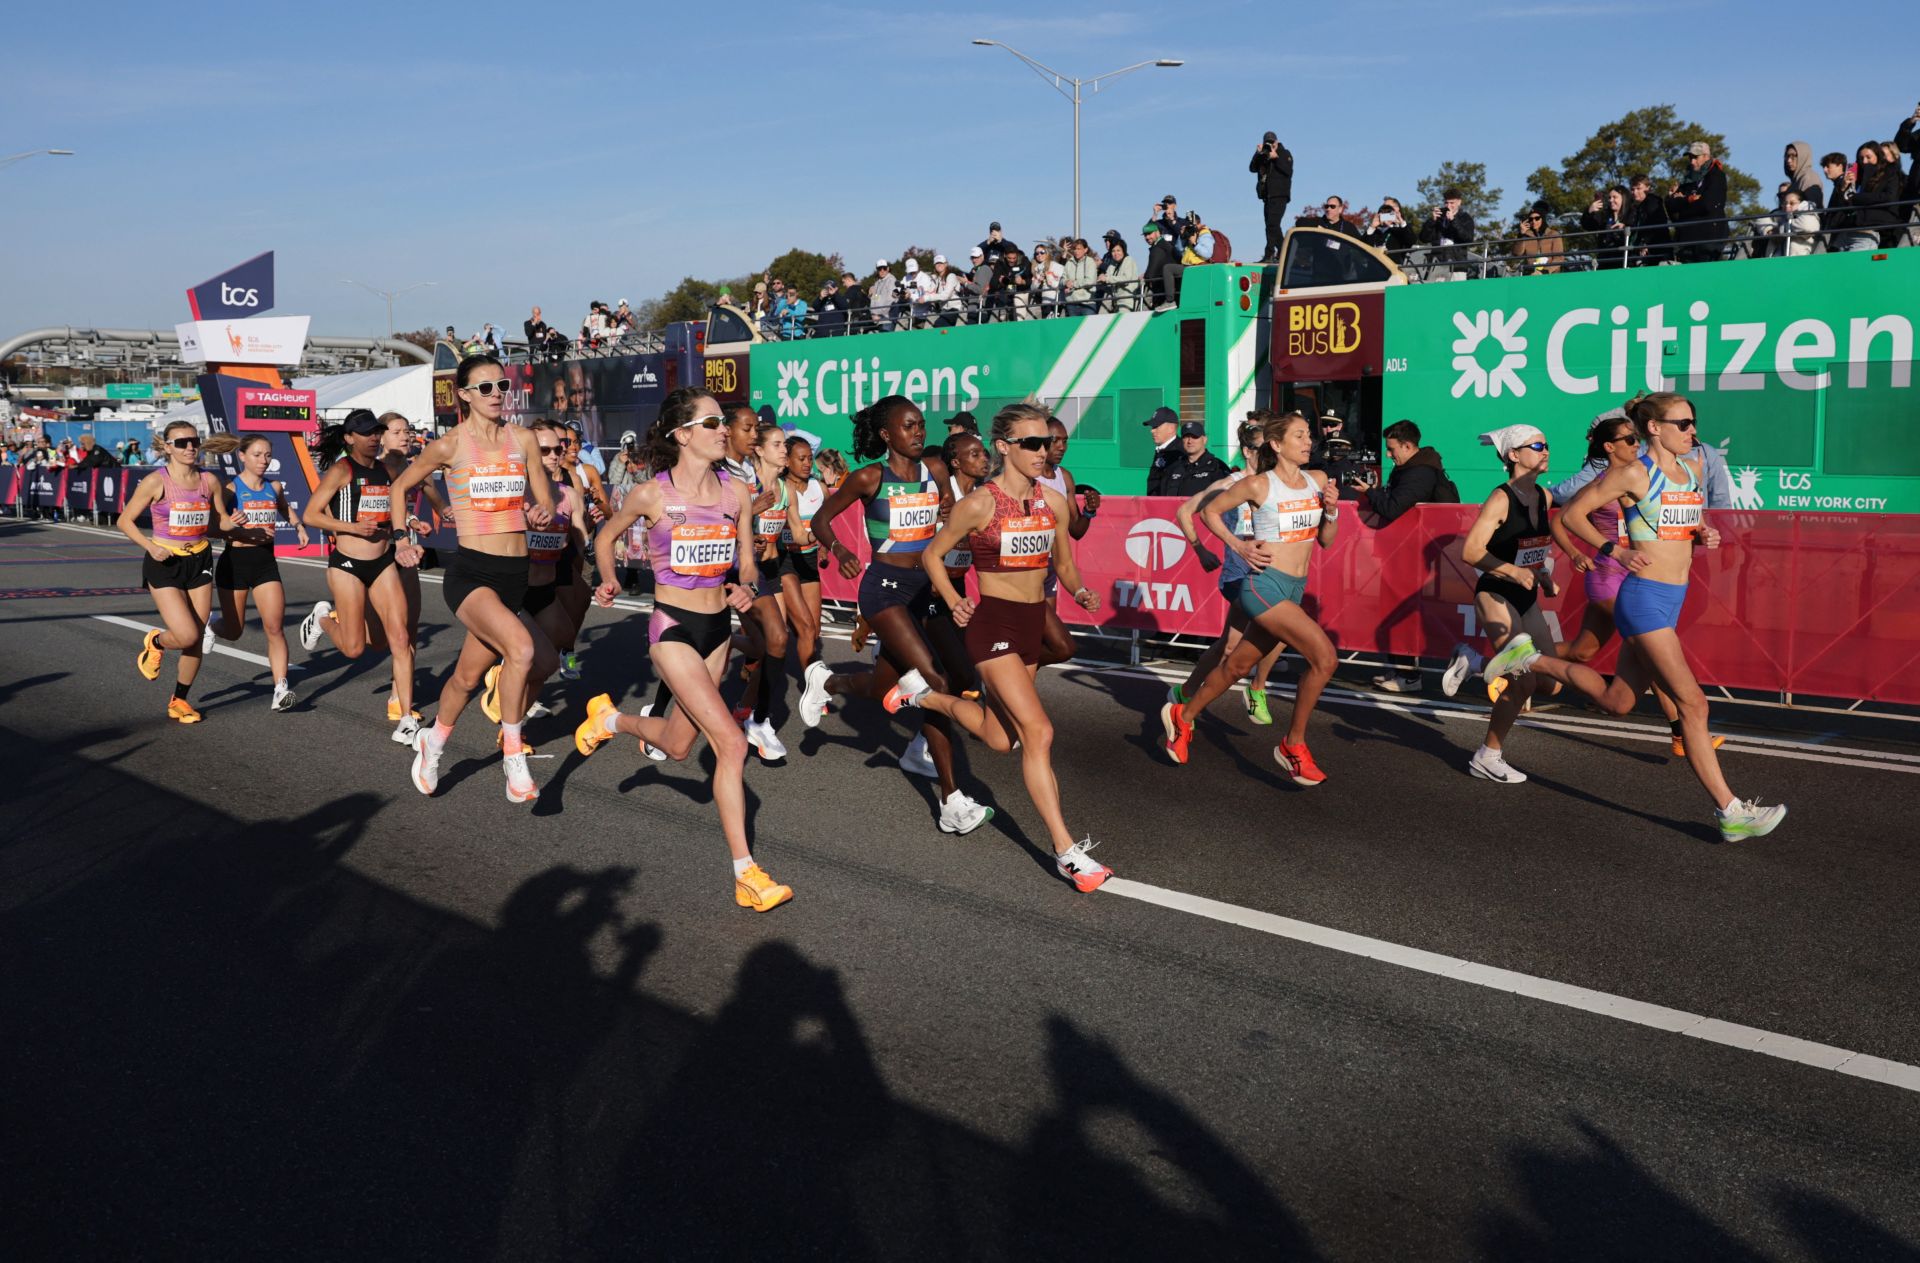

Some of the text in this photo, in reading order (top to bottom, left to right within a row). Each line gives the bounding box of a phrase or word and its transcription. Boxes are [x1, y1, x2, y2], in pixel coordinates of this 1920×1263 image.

[222, 281, 259, 307] tcs
[1289, 303, 1329, 332] BIG
[1289, 331, 1329, 356] BUS
[1545, 300, 1914, 395] Citizen
[705, 359, 723, 377] BIG
[1385, 358, 1408, 372] ADL5
[705, 377, 723, 393] BUS
[471, 480, 524, 493] WARNER-JUDD
[1779, 468, 1811, 490] tcs
[1778, 495, 1888, 510] NEW YORK CITY
[177, 513, 205, 526] MAYER
[899, 509, 934, 527] LOKEDI
[1291, 513, 1313, 529] HALL
[1661, 508, 1699, 525] SULLIVAN
[680, 527, 696, 537] tcs
[530, 534, 562, 549] FRISBIE
[1011, 533, 1050, 555] SISSON
[676, 543, 732, 563] O'KEEFFE
[1522, 549, 1546, 565] SEIDEL
[1115, 580, 1195, 613] TATA
